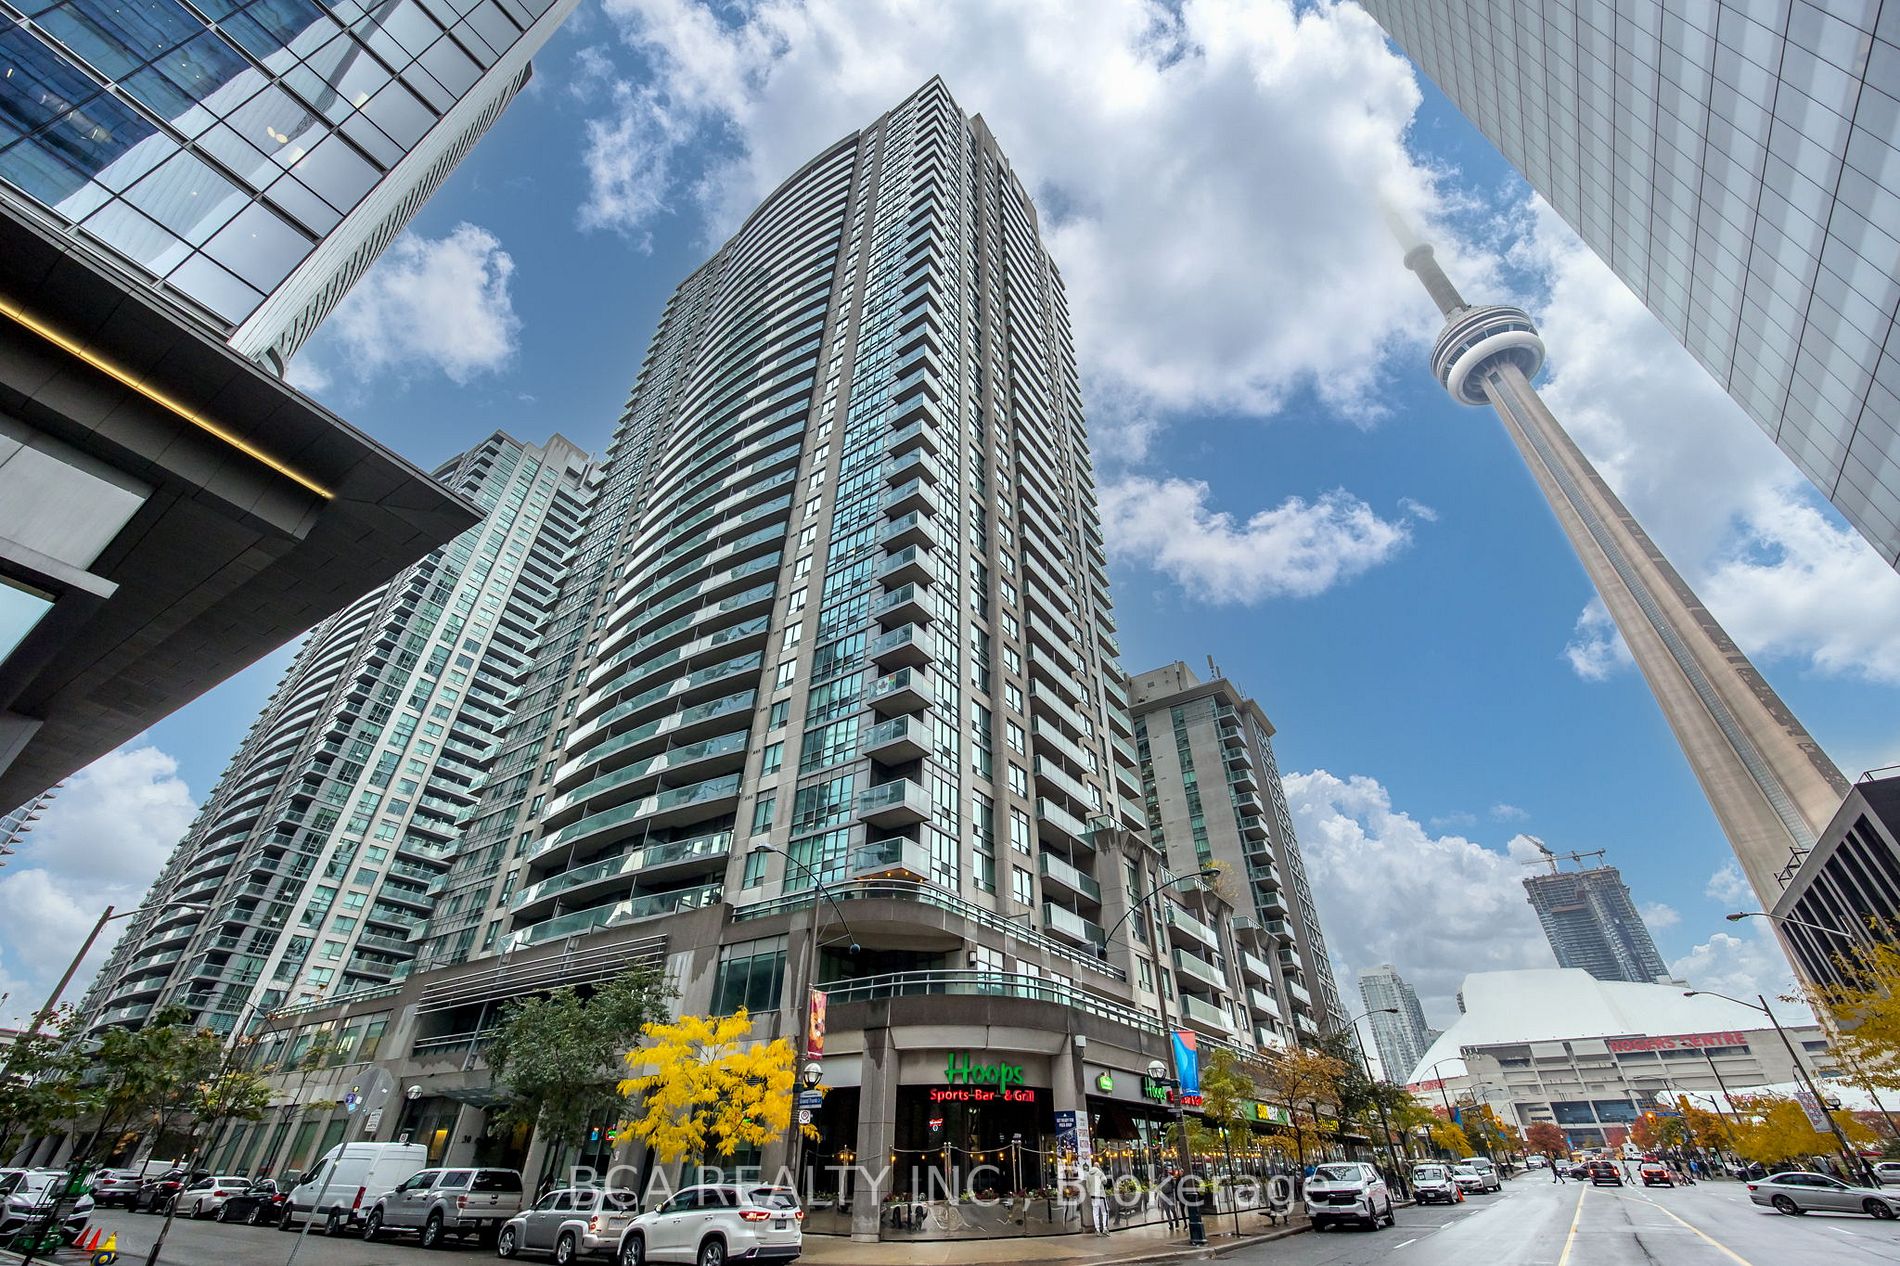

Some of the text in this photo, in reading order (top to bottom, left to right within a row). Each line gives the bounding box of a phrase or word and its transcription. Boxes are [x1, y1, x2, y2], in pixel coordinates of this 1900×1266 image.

[1610, 1032, 1748, 1053] ROGERS CENTRE
[944, 1052, 1025, 1094] Hoops
[930, 1089, 1035, 1103] Sports Bar & Grill
